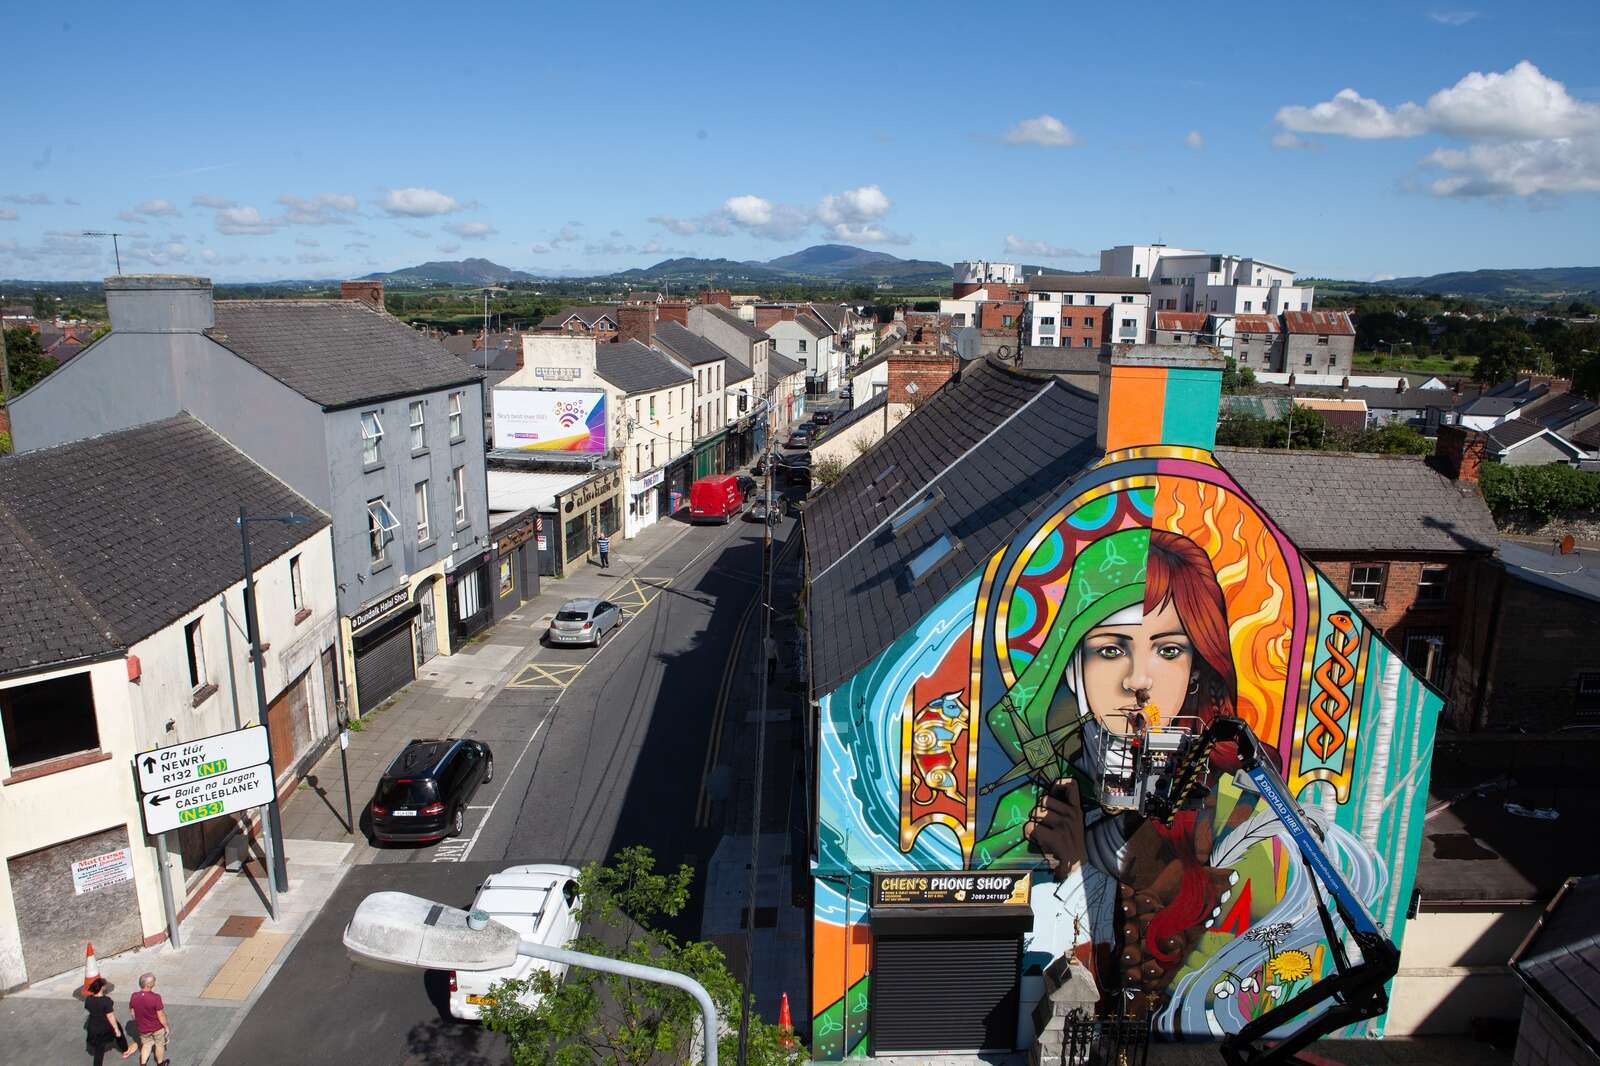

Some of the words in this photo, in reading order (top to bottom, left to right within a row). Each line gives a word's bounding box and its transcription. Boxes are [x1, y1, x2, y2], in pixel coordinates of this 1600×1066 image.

[357, 606, 380, 626] Dundalk
[380, 598, 394, 612] Halal
[394, 592, 408, 604] Shop
[162, 754, 206, 772] NEWRY
[164, 770, 192, 784] R132
[198, 758, 228, 777] (N1)
[175, 786, 200, 798] Baile
[206, 782, 217, 790] na
[223, 771, 256, 786] Lorgan
[176, 780, 260, 808] CASTLEBLANEY
[180, 801, 224, 823] (N53)
[1260, 780, 1287, 815] DROMAD
[1284, 814, 1301, 834] HIRE
[80, 851, 124, 867] Mattress
[881, 877, 928, 890] CHEN'S
[931, 878, 974, 890] PHONE
[976, 878, 1012, 890] SHOP
